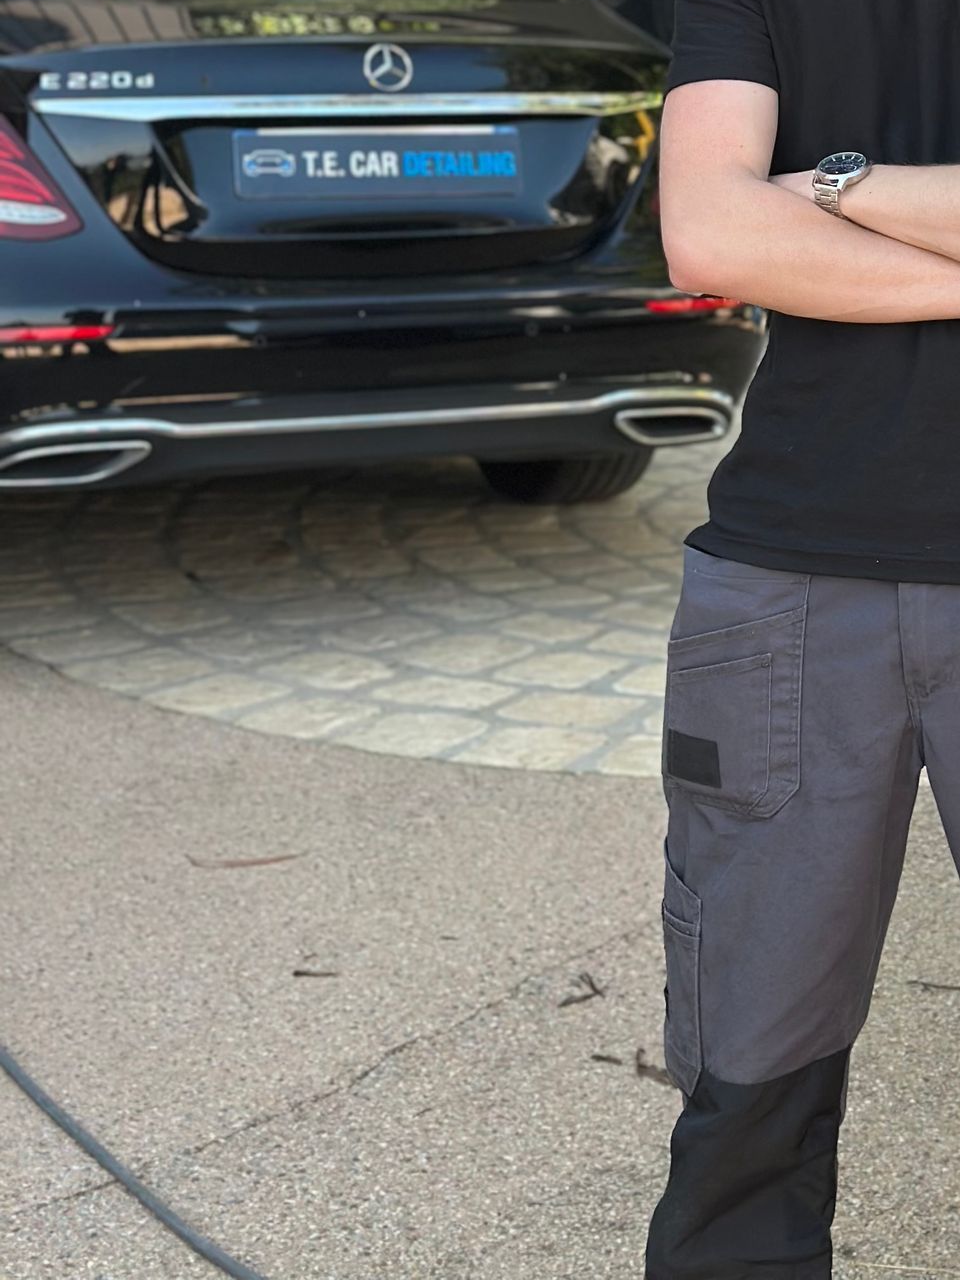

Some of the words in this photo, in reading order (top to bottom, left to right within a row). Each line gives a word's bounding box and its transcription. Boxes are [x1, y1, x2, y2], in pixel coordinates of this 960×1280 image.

[40, 71, 61, 90] E
[302, 151, 347, 178] T.E.
[350, 151, 399, 178] CAR
[402, 151, 516, 178] DETAILING
